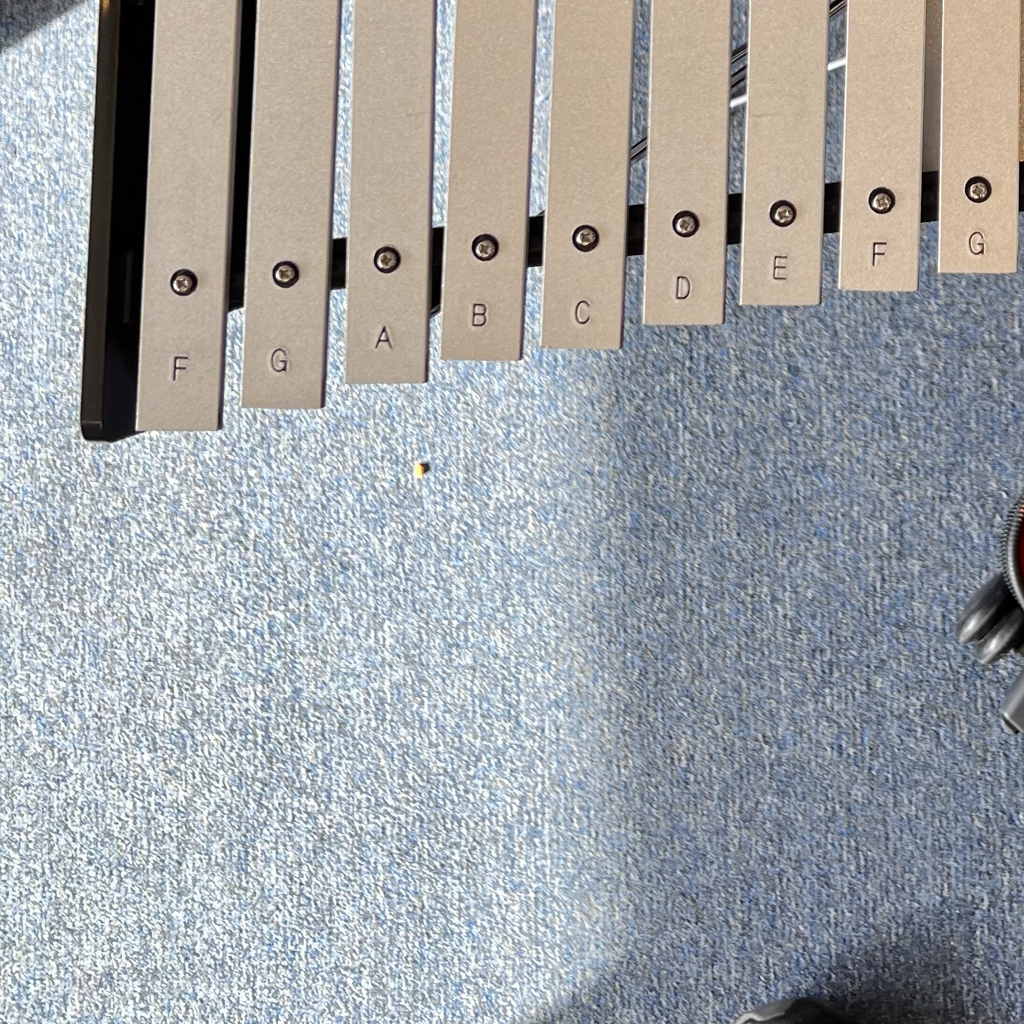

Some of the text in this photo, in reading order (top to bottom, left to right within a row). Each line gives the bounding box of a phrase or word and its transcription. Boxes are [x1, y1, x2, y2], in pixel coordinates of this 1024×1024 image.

[871, 241, 888, 268] F
[968, 231, 985, 256] G
[772, 255, 789, 281] E
[675, 275, 691, 301] D
[471, 302, 488, 328] B
[574, 299, 591, 325] C
[374, 325, 393, 350] A
[172, 355, 191, 382] F
[270, 347, 289, 373] G
